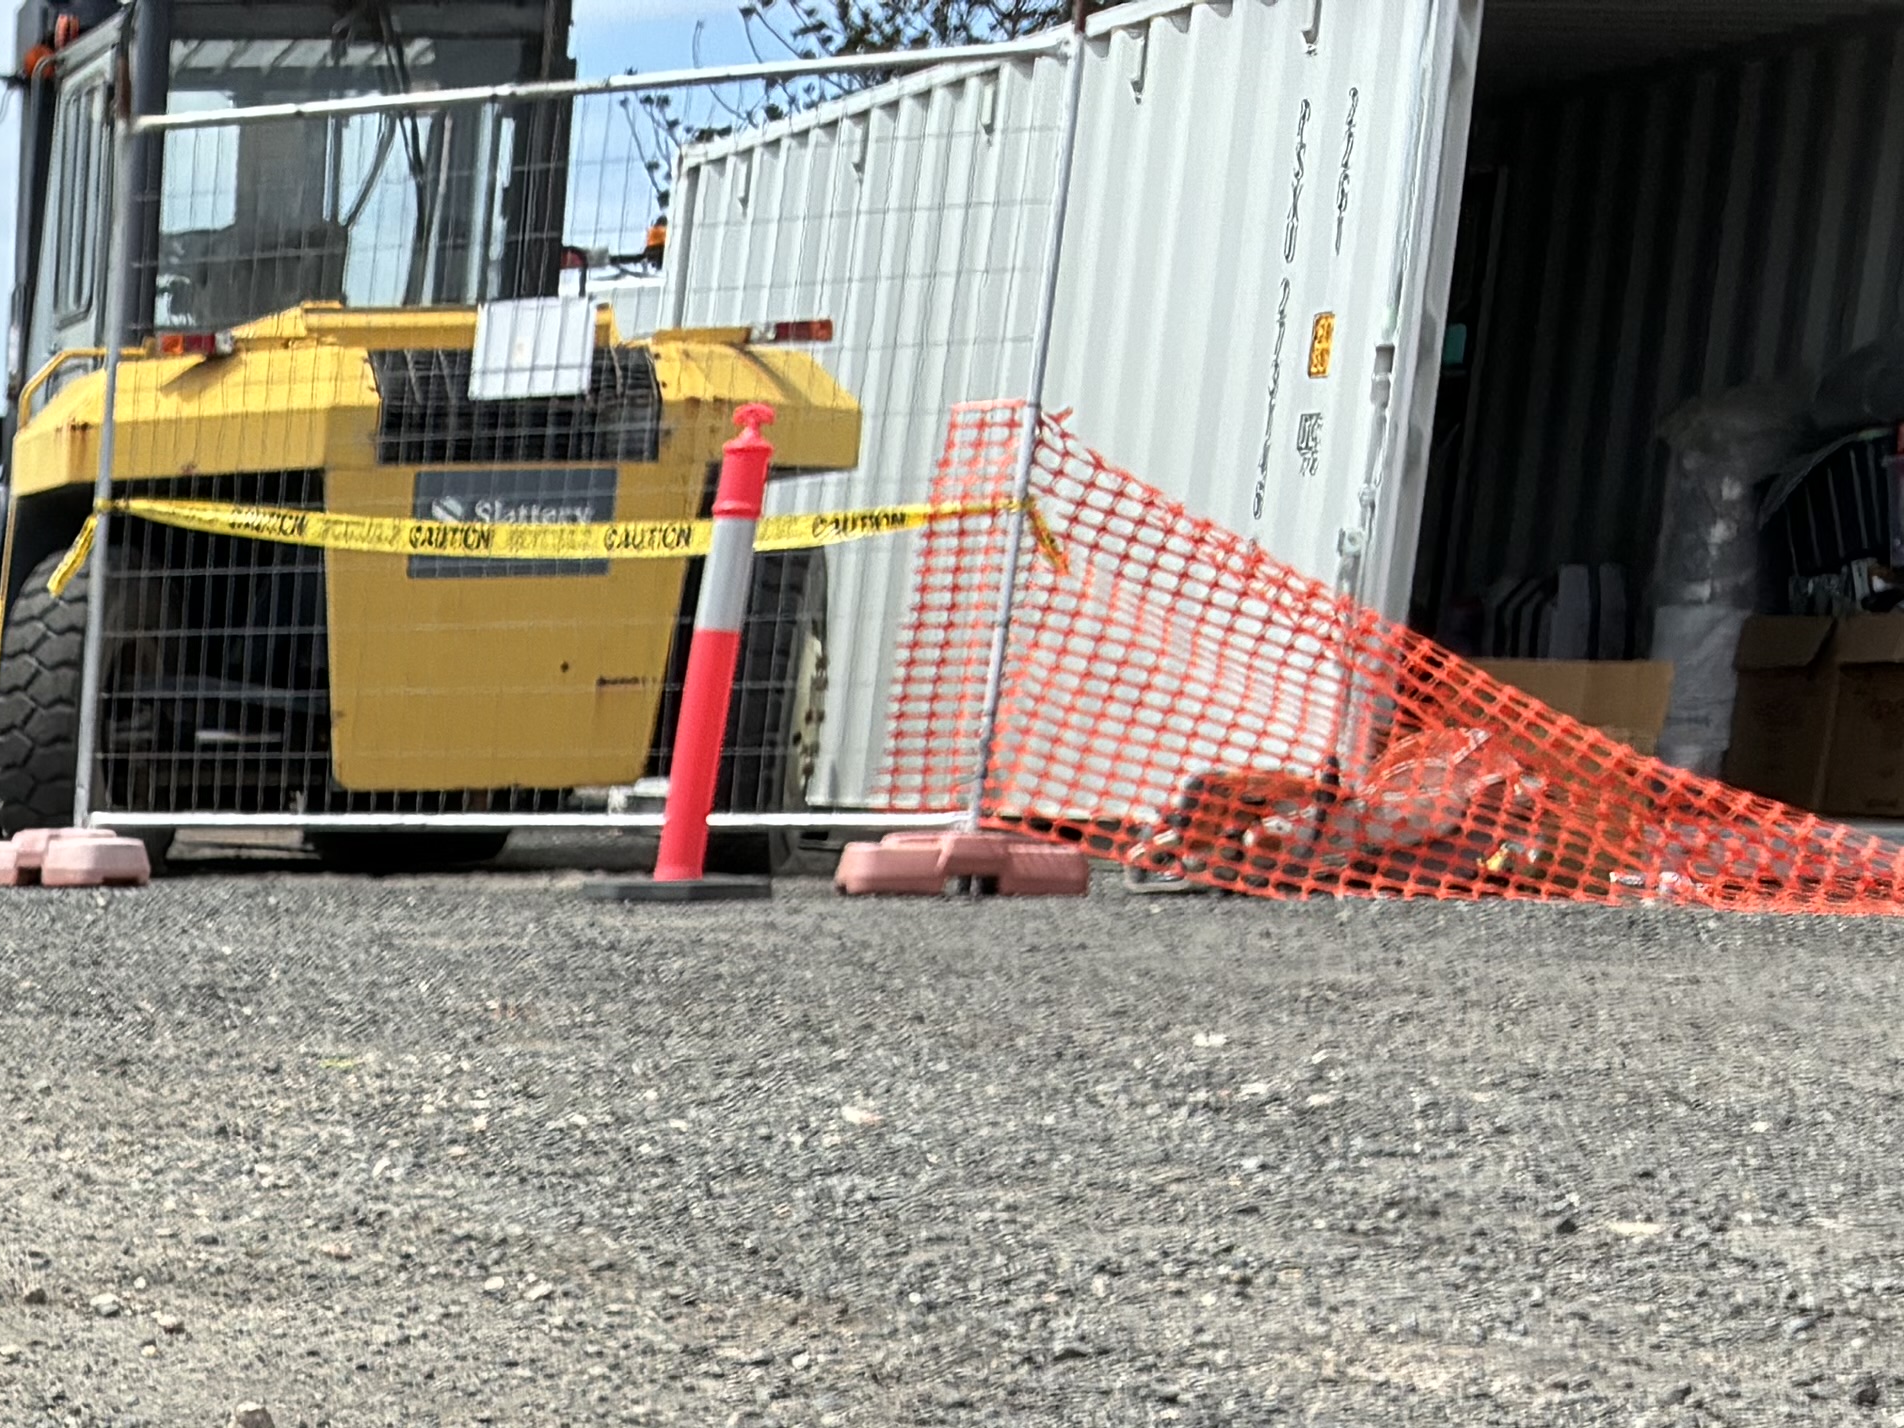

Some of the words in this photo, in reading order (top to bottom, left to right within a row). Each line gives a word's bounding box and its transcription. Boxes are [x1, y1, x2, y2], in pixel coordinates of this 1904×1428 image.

[409, 524, 492, 550] CAUTION
[603, 525, 692, 551] CAUTION
[811, 511, 908, 538] CAUTION
